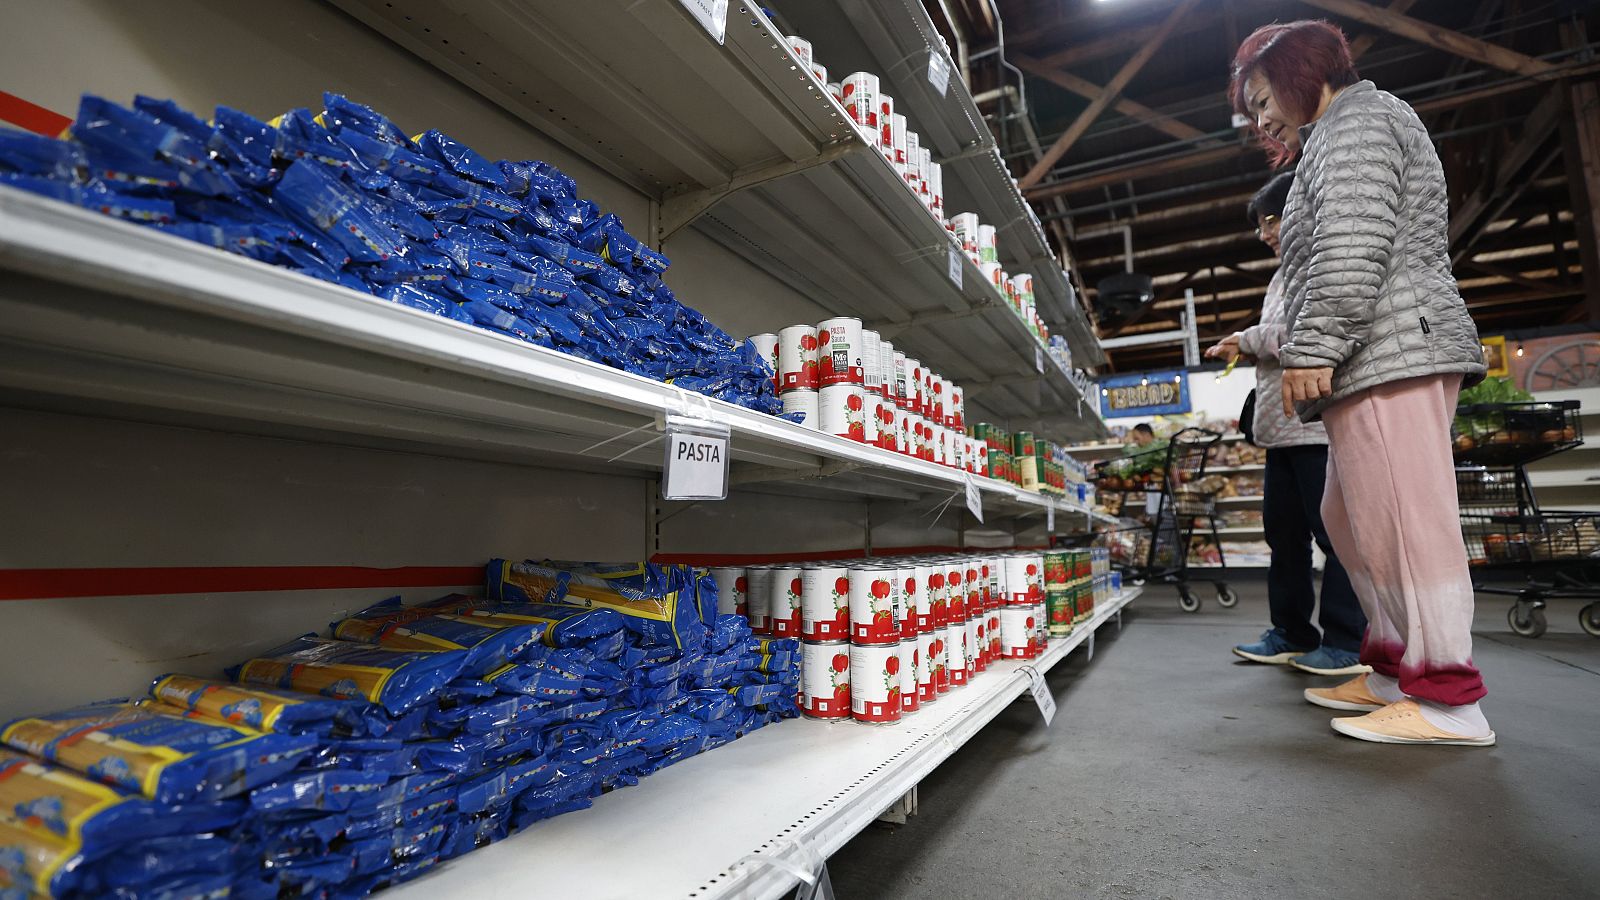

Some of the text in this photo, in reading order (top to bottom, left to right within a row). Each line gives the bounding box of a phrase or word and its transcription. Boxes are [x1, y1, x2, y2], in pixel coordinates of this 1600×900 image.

[831, 326, 846, 335] PASTA
[1113, 383, 1173, 408] BREAD
[677, 441, 720, 463] PASTA
